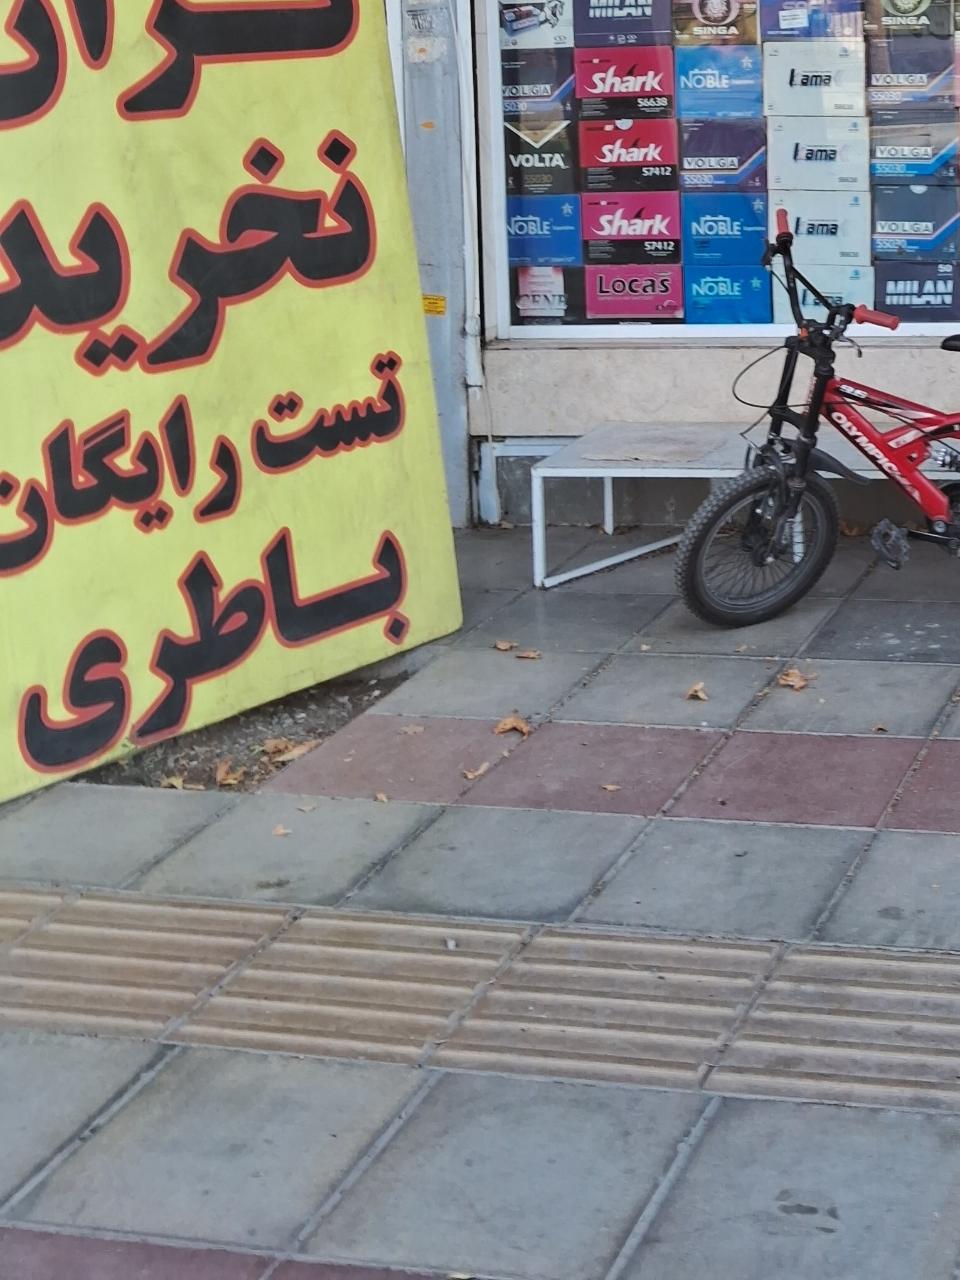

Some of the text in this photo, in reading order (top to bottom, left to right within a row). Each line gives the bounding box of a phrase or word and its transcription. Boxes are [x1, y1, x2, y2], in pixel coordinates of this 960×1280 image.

[881, 16, 931, 26] SINGA
[693, 26, 739, 36] SINGA
[584, 64, 665, 95] Shark
[680, 74, 730, 88] NOBLE
[872, 74, 927, 85] VOLGA
[594, 138, 663, 163] Shark
[876, 146, 932, 158] VOLGA
[509, 153, 565, 169] VOLTA
[684, 158, 738, 169] VOLGA
[508, 220, 550, 235] NOBLE
[592, 208, 671, 236] Shark
[691, 222, 741, 235] NOBLE
[876, 221, 934, 233] VOLGA
[692, 282, 741, 296] NOBLE
[885, 280, 954, 305] MILAN
[250, 350, 407, 476] تست
[830, 411, 901, 477] OLYMPIC
[18, 526, 411, 775] باطری
